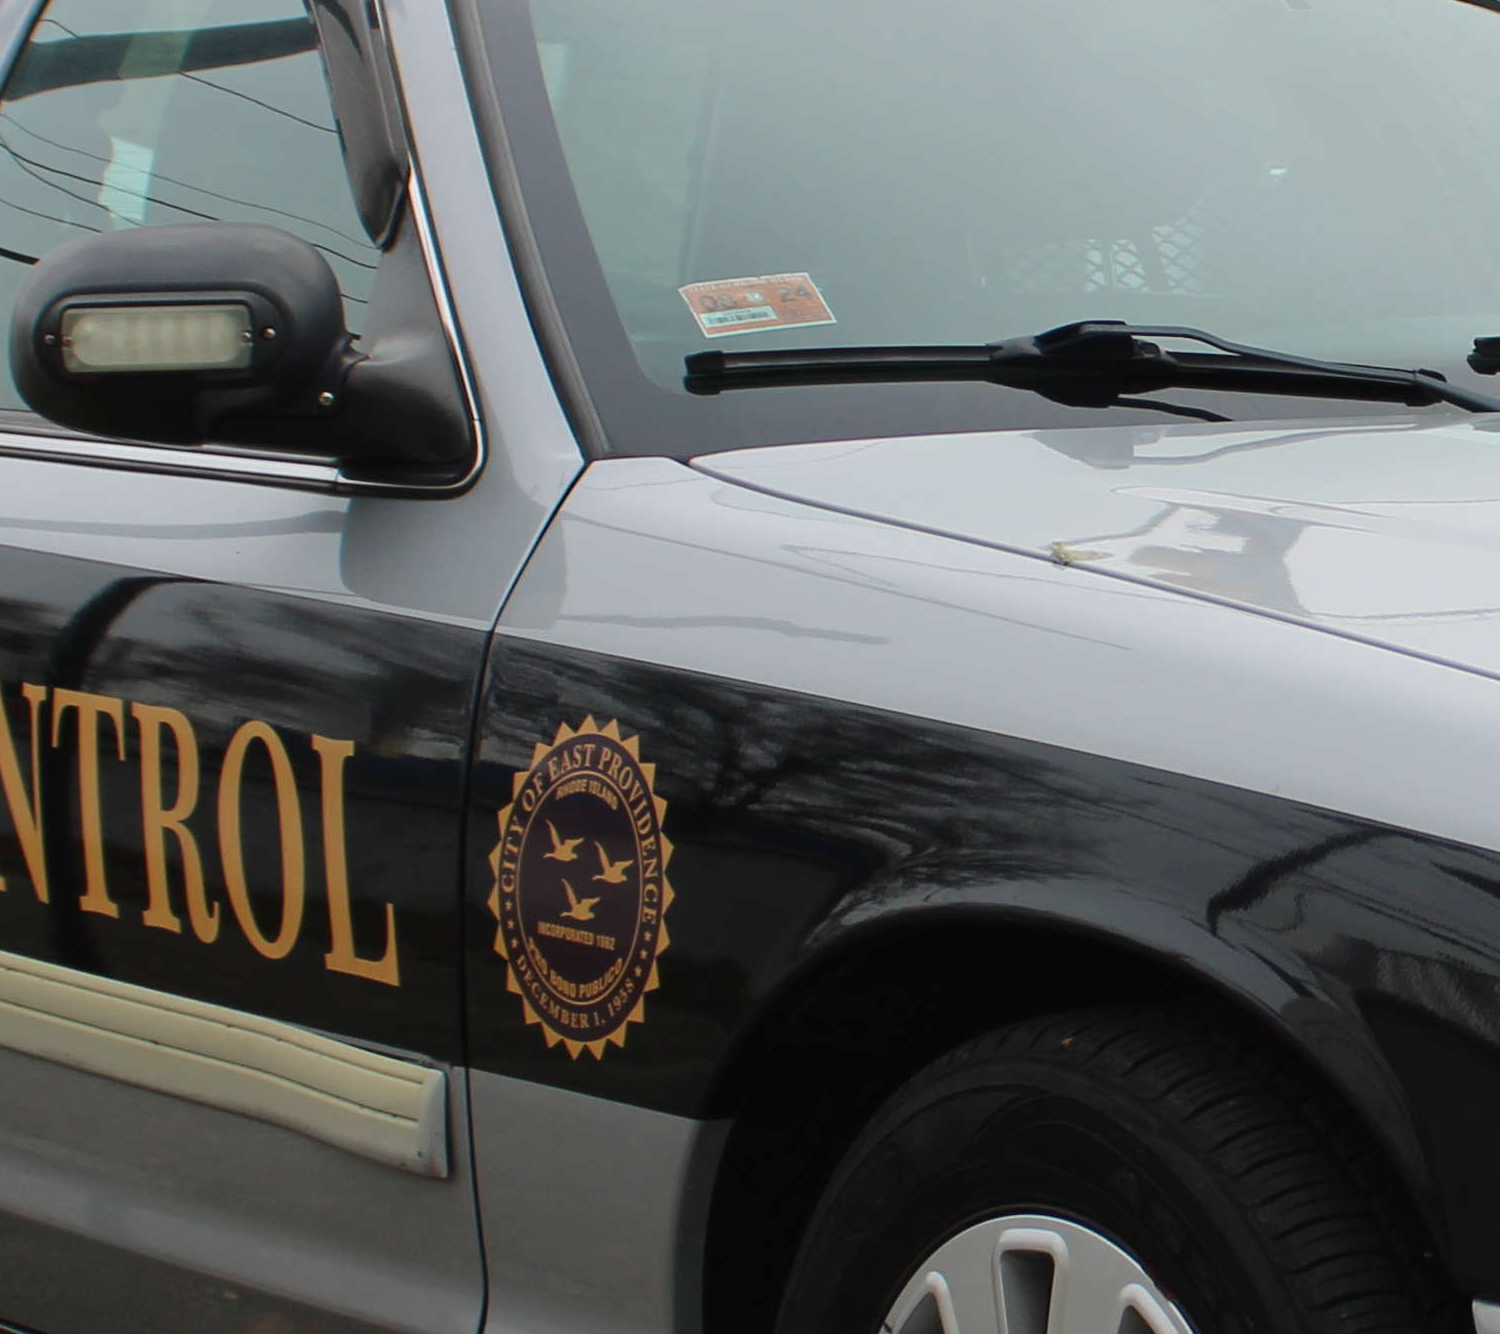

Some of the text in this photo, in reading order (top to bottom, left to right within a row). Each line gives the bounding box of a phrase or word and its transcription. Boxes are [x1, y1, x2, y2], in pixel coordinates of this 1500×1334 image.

[699, 284, 813, 312] 08 24
[555, 778, 619, 811] RHODE ISLAND
[501, 743, 659, 925] CITY OF EAST PROVIDENCE
[537, 921, 594, 946] INCORPORATED
[516, 954, 635, 1029] DECEMBER 1, 1958
[549, 969, 577, 998] BONO
[578, 957, 623, 999] PUBLICO
